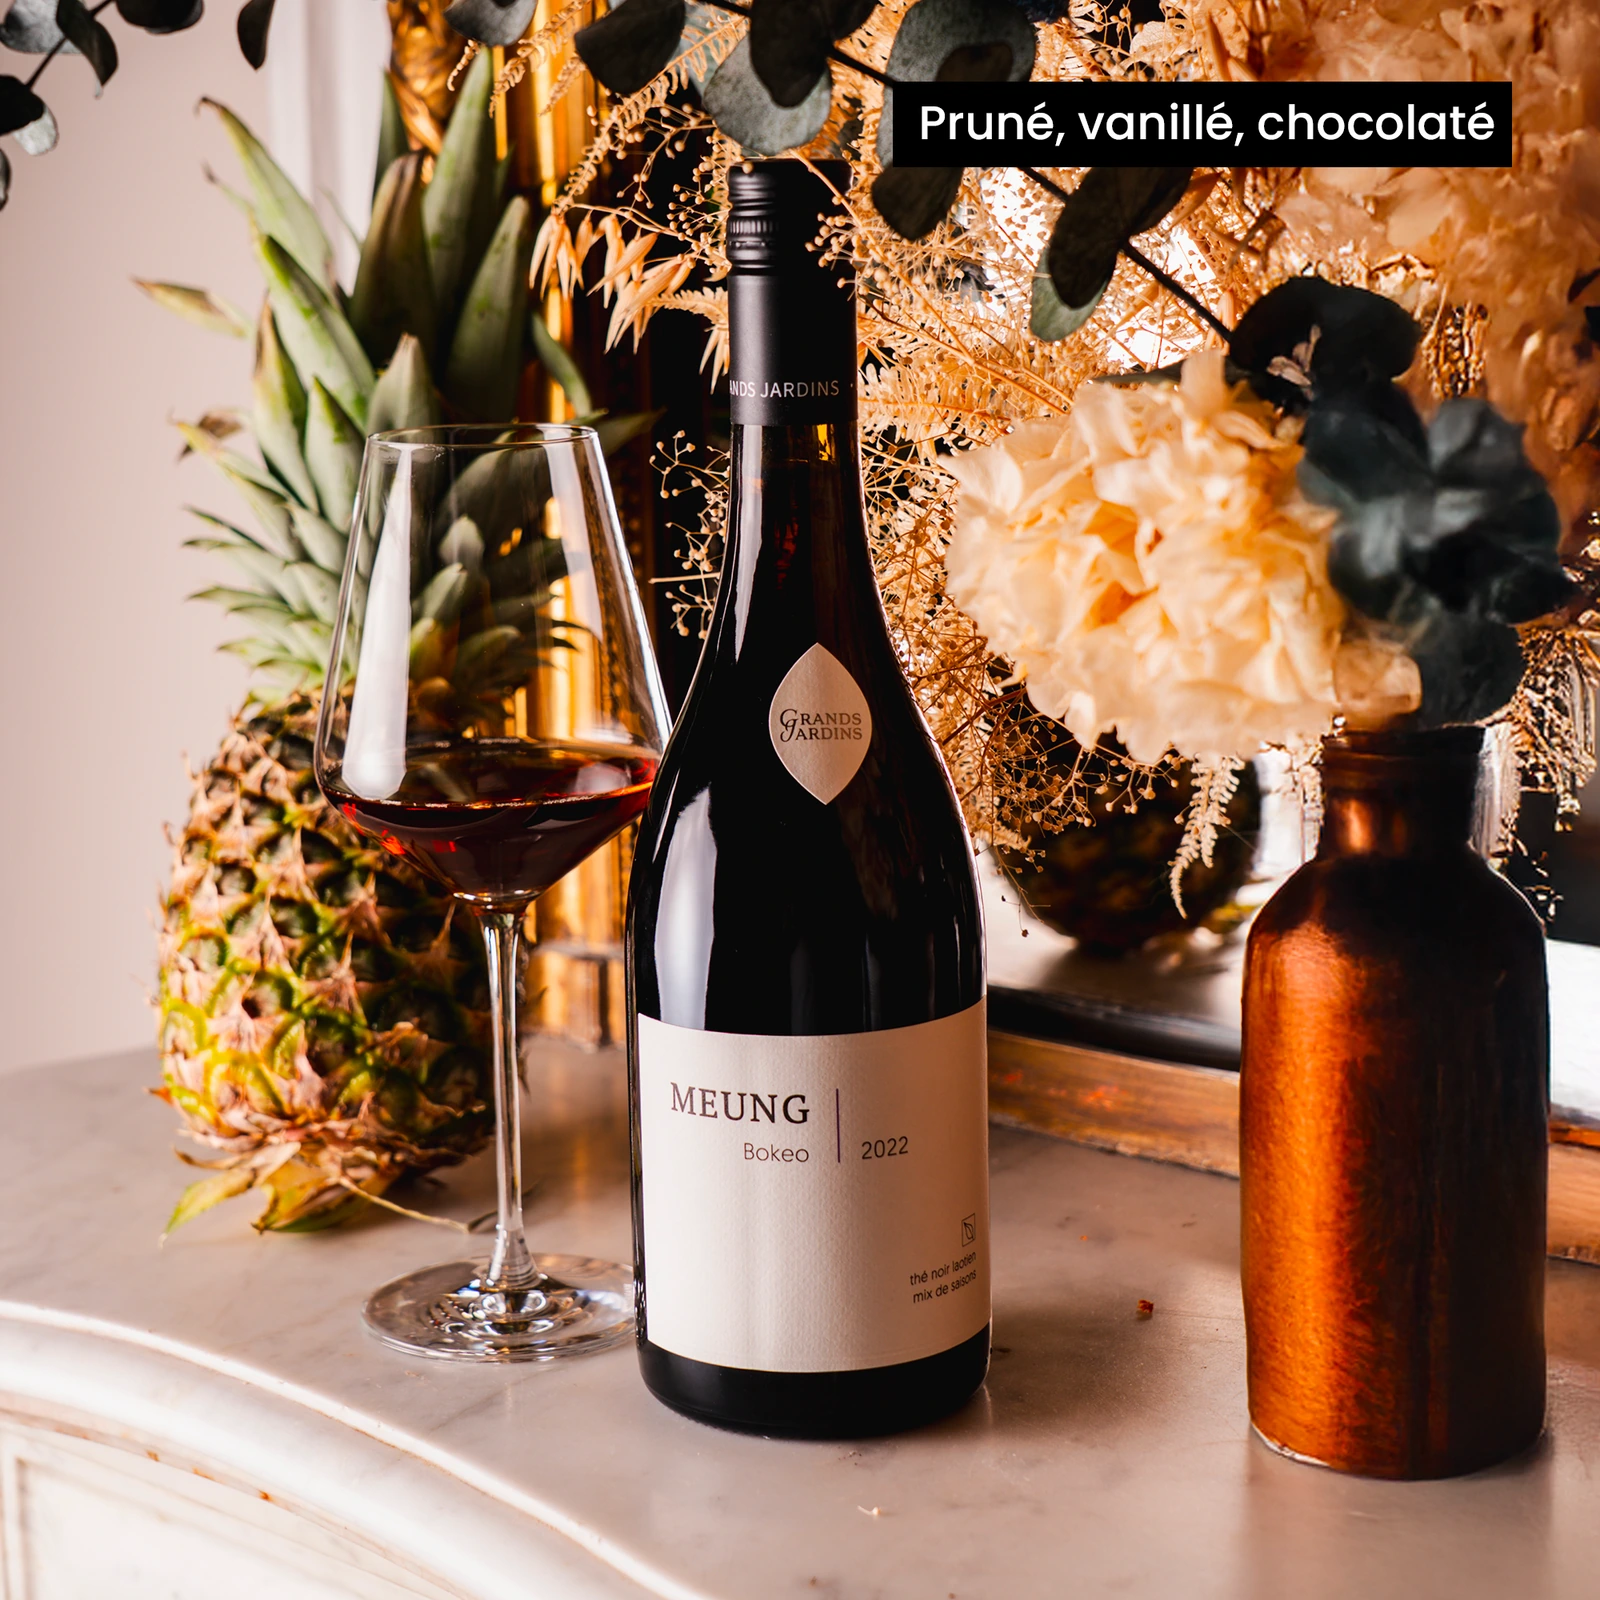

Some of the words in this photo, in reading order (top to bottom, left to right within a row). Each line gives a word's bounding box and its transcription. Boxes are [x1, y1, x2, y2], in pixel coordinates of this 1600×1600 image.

[760, 380, 839, 398] JARDINS
[670, 1081, 810, 1125] MEUNG
[743, 1142, 810, 1163] Bokeo
[861, 1135, 909, 1160] 2022
[909, 1270, 928, 1286] thé
[931, 1263, 950, 1280] noir
[952, 1251, 976, 1272] laotien
[913, 1289, 933, 1303] mix
[935, 1283, 949, 1297] de
[951, 1269, 977, 1292] saisons
